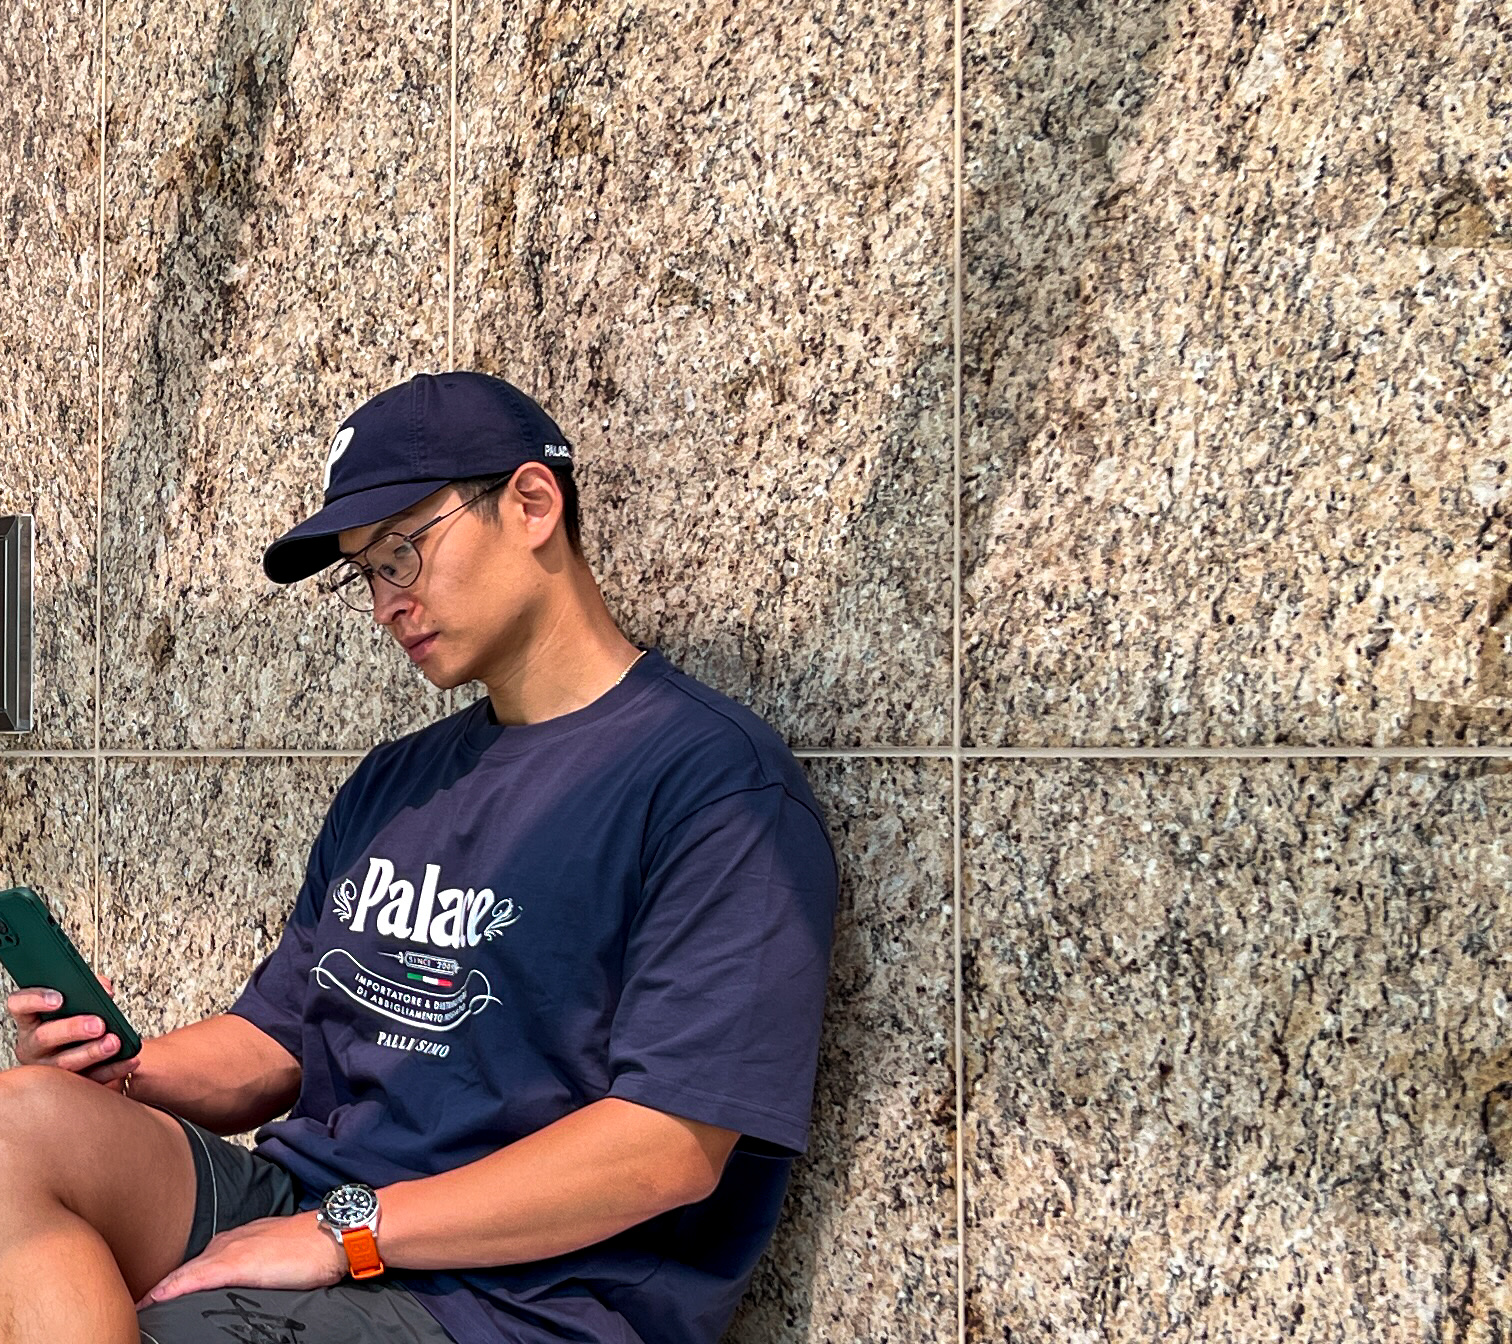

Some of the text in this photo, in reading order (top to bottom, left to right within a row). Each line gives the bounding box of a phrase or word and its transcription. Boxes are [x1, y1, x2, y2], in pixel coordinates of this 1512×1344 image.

[323, 427, 355, 492] P
[355, 972, 423, 1008] IMPORTATORE
[356, 985, 368, 998] DI
[369, 994, 443, 1023] ABBIGLIAMENTO
